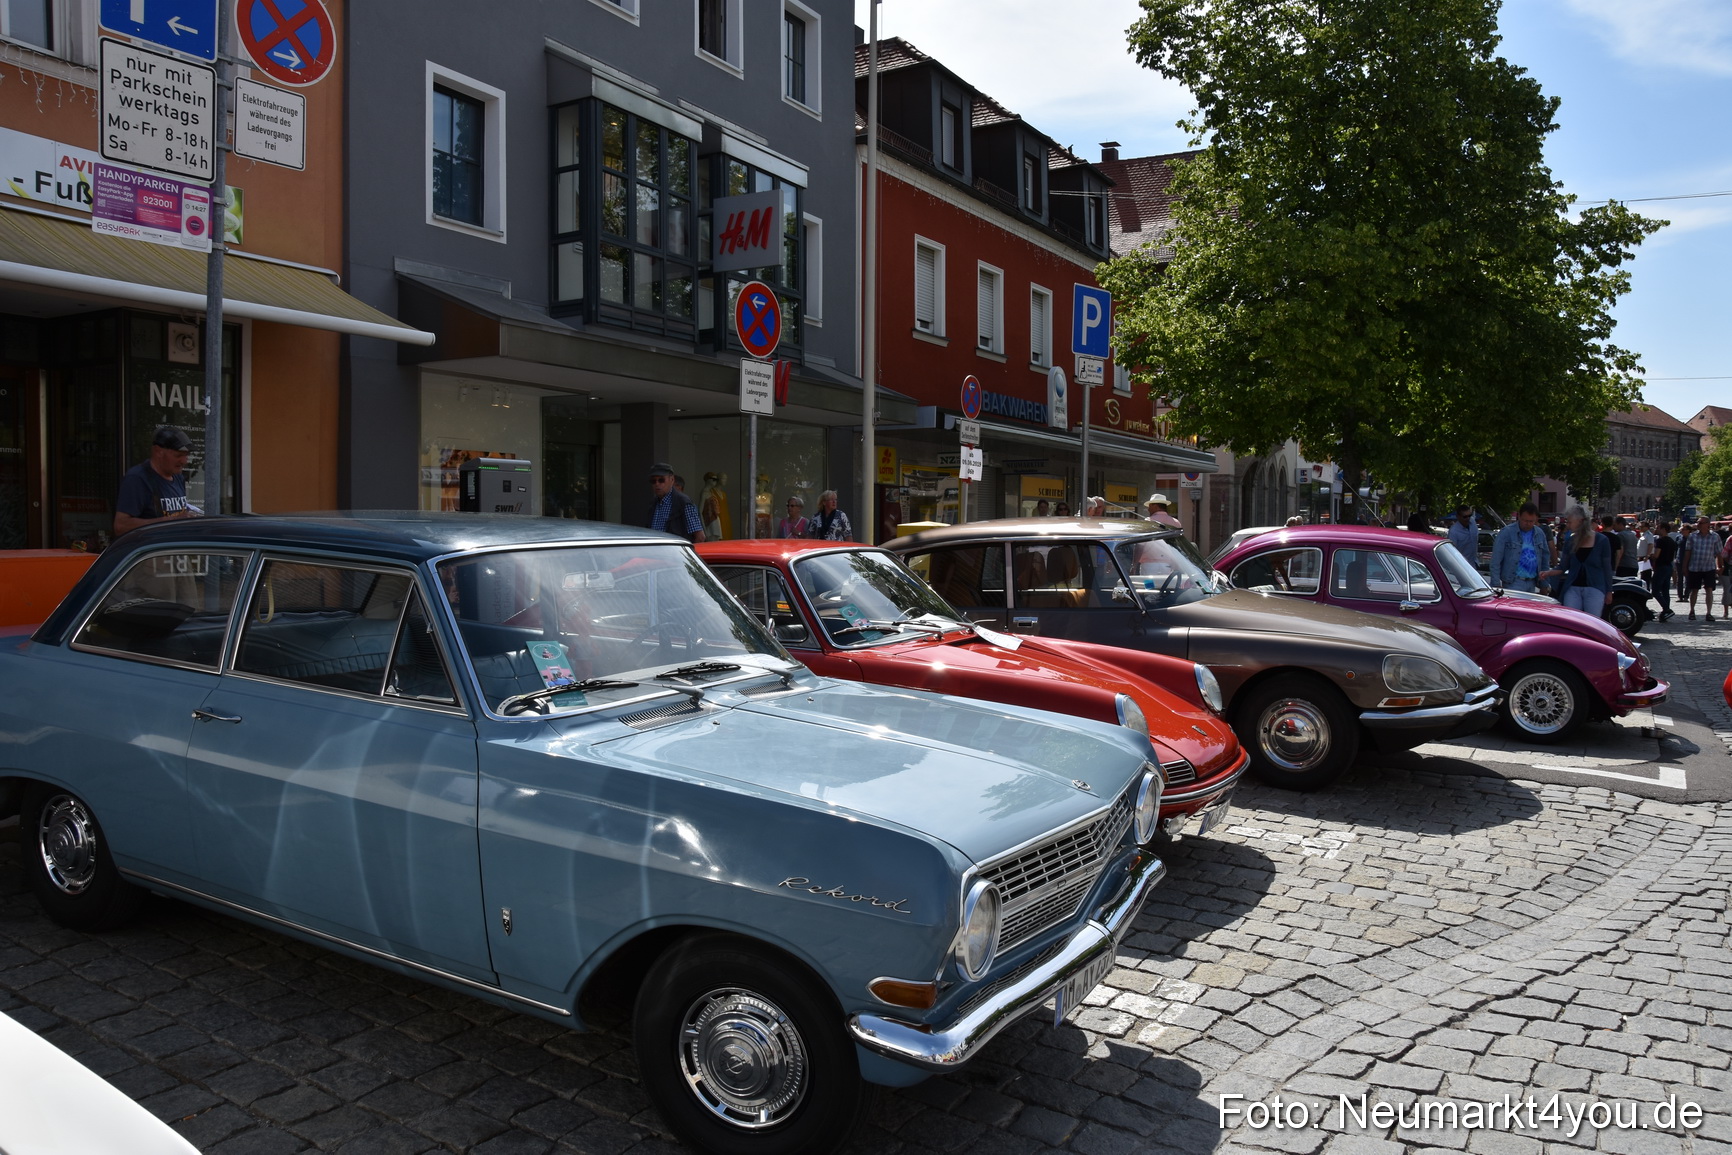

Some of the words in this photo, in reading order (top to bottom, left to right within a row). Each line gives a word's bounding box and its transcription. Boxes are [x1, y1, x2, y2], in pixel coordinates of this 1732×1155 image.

[126, 56, 156, 75] nur
[166, 67, 192, 86] mit
[110, 68, 206, 108] Parkschein
[119, 94, 200, 126] werktags
[242, 93, 298, 118] Elektrofahrzeuge
[248, 122, 292, 142] Ladevorgangs
[250, 110, 278, 124] während
[280, 117, 291, 128] des
[109, 134, 128, 152] Sa
[264, 140, 276, 151] frei
[36, 170, 93, 205] Fuß
[98, 168, 179, 194] HANDYPARKEN
[143, 196, 173, 209] 923001
[719, 206, 773, 255] H&M
[1082, 295, 1102, 346] P
[880, 467, 894, 475] LOTTO
[778, 876, 912, 914] Rekord
